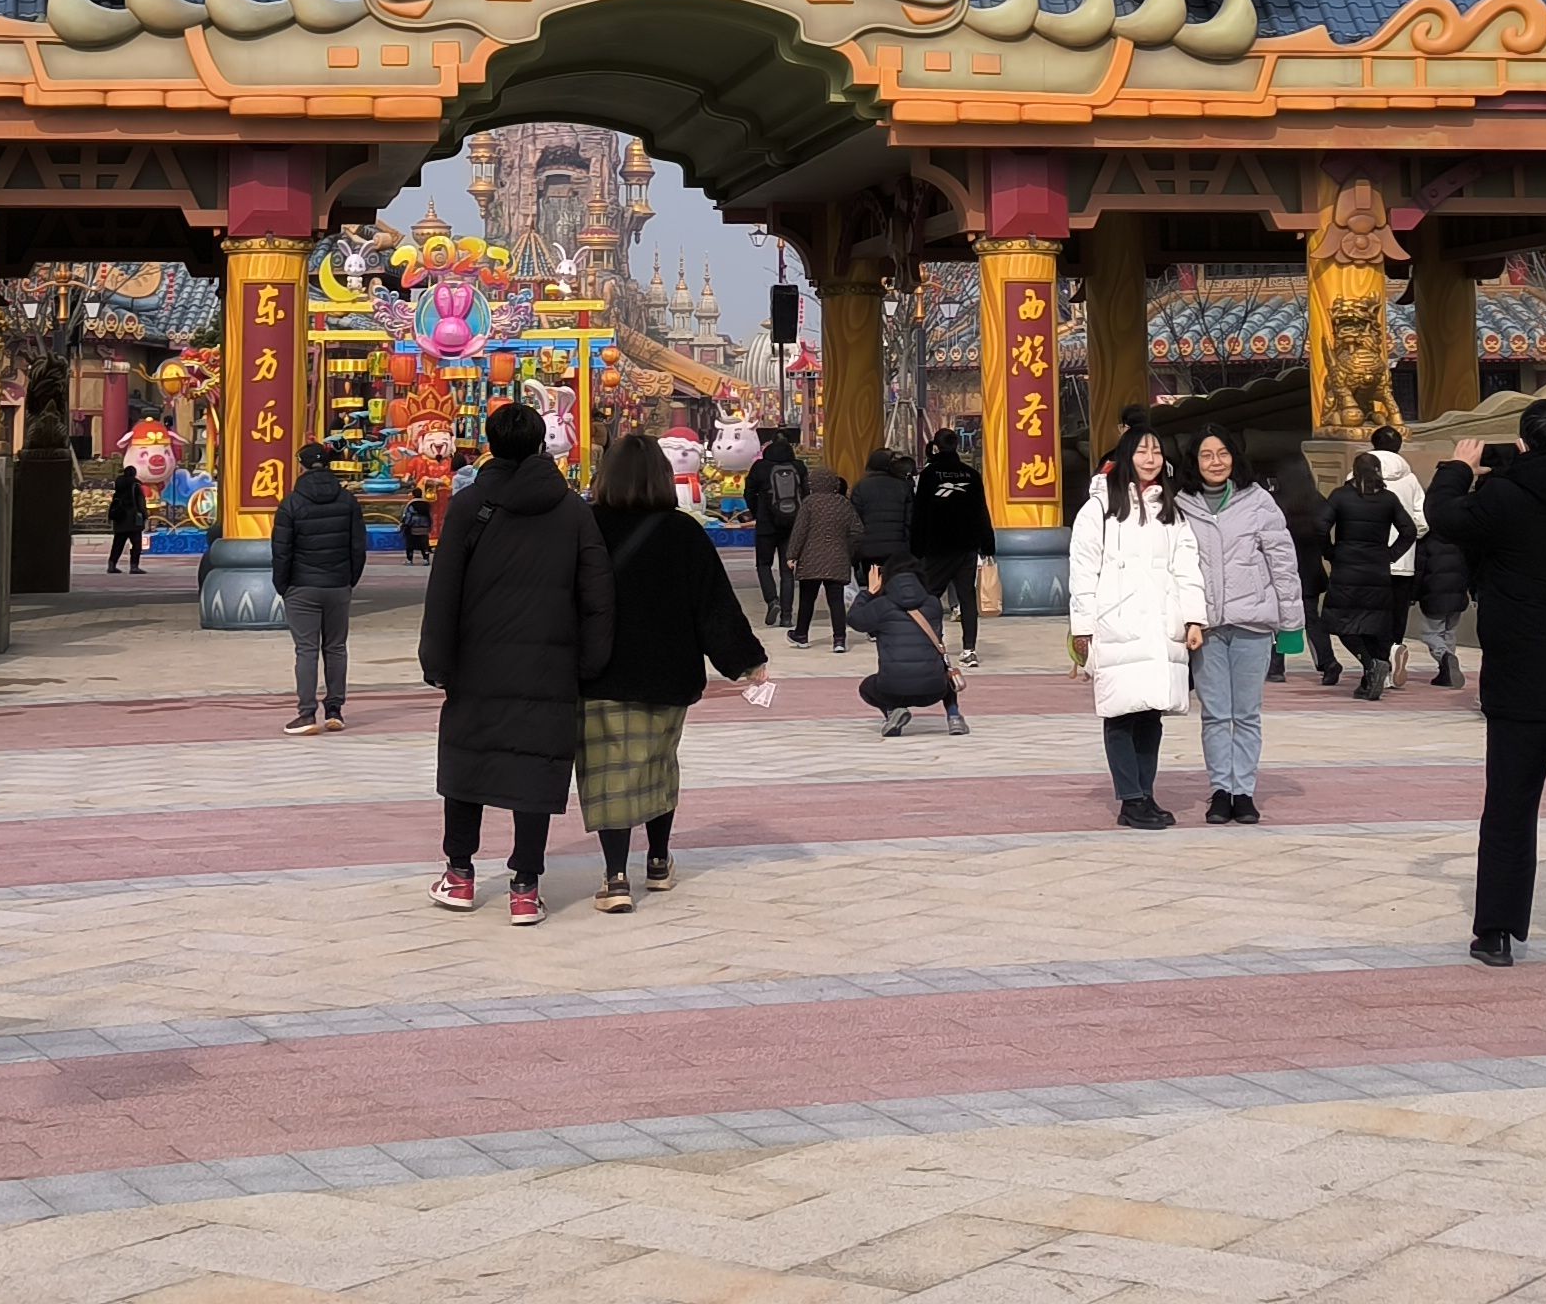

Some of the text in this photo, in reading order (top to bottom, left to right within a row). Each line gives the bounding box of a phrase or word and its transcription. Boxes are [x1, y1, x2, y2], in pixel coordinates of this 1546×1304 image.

[390, 235, 511, 291] 2023
[251, 284, 285, 502] 东方乐园
[1011, 288, 1056, 490] 西游圣地
